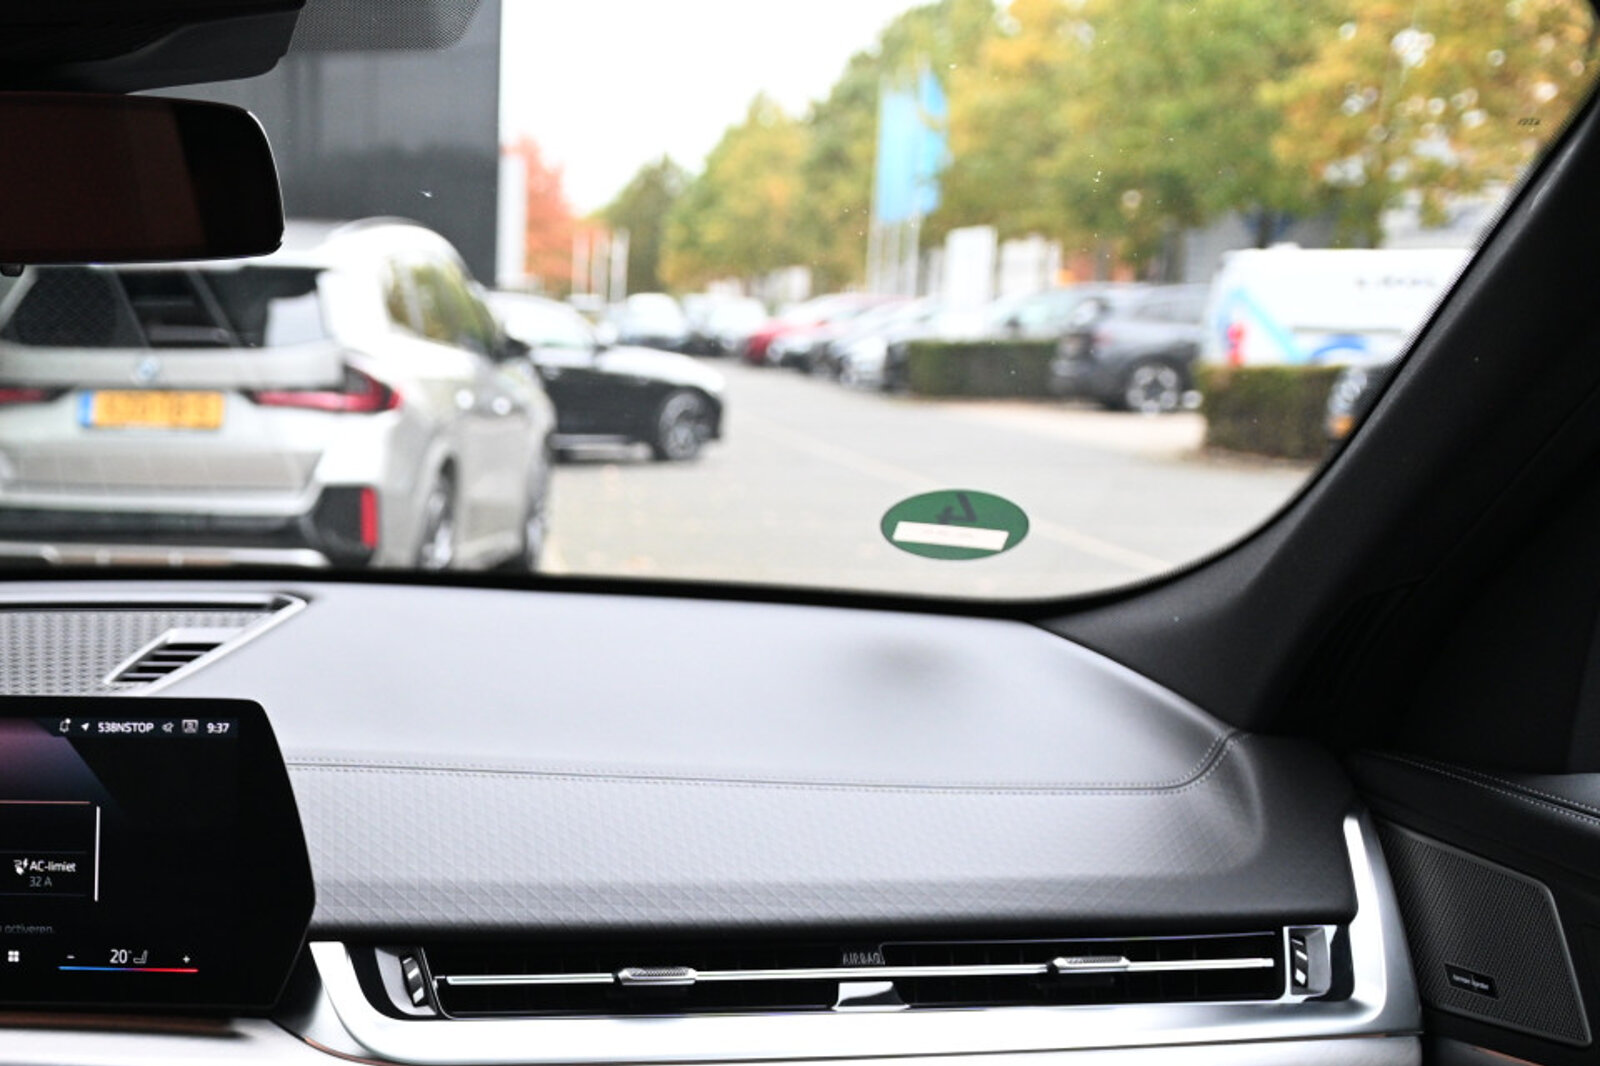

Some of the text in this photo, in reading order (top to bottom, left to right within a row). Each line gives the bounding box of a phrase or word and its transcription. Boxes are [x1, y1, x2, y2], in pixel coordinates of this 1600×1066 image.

[206, 722, 230, 734] 9:37
[29, 861, 76, 873] AC-limiet
[29, 876, 43, 887] 32
